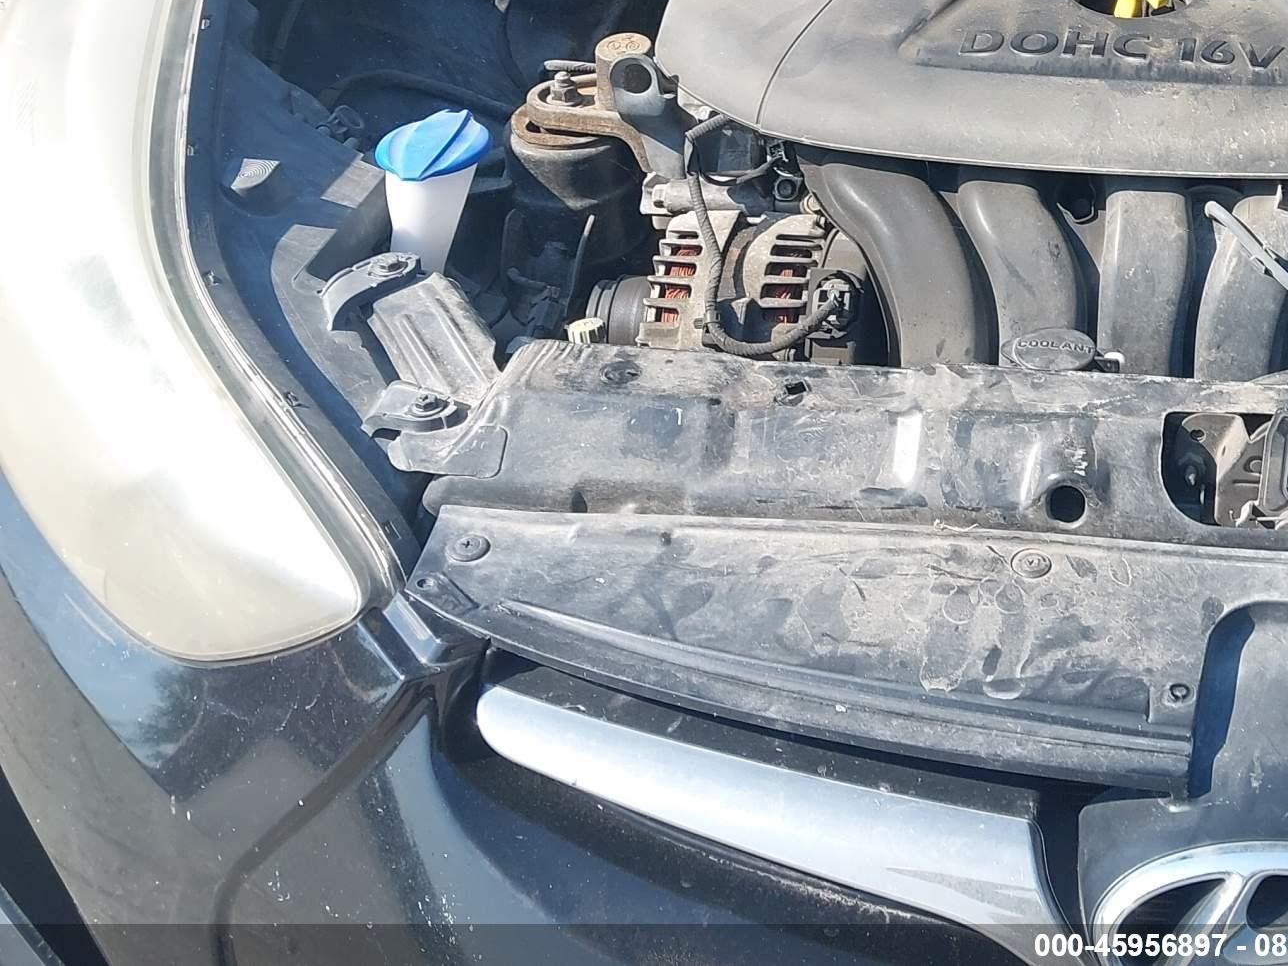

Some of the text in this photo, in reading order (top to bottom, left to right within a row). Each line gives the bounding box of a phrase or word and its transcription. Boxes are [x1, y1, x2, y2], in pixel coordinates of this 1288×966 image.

[958, 29, 1286, 70] DOHC 16V
[1017, 339, 1095, 354] COOLANT
